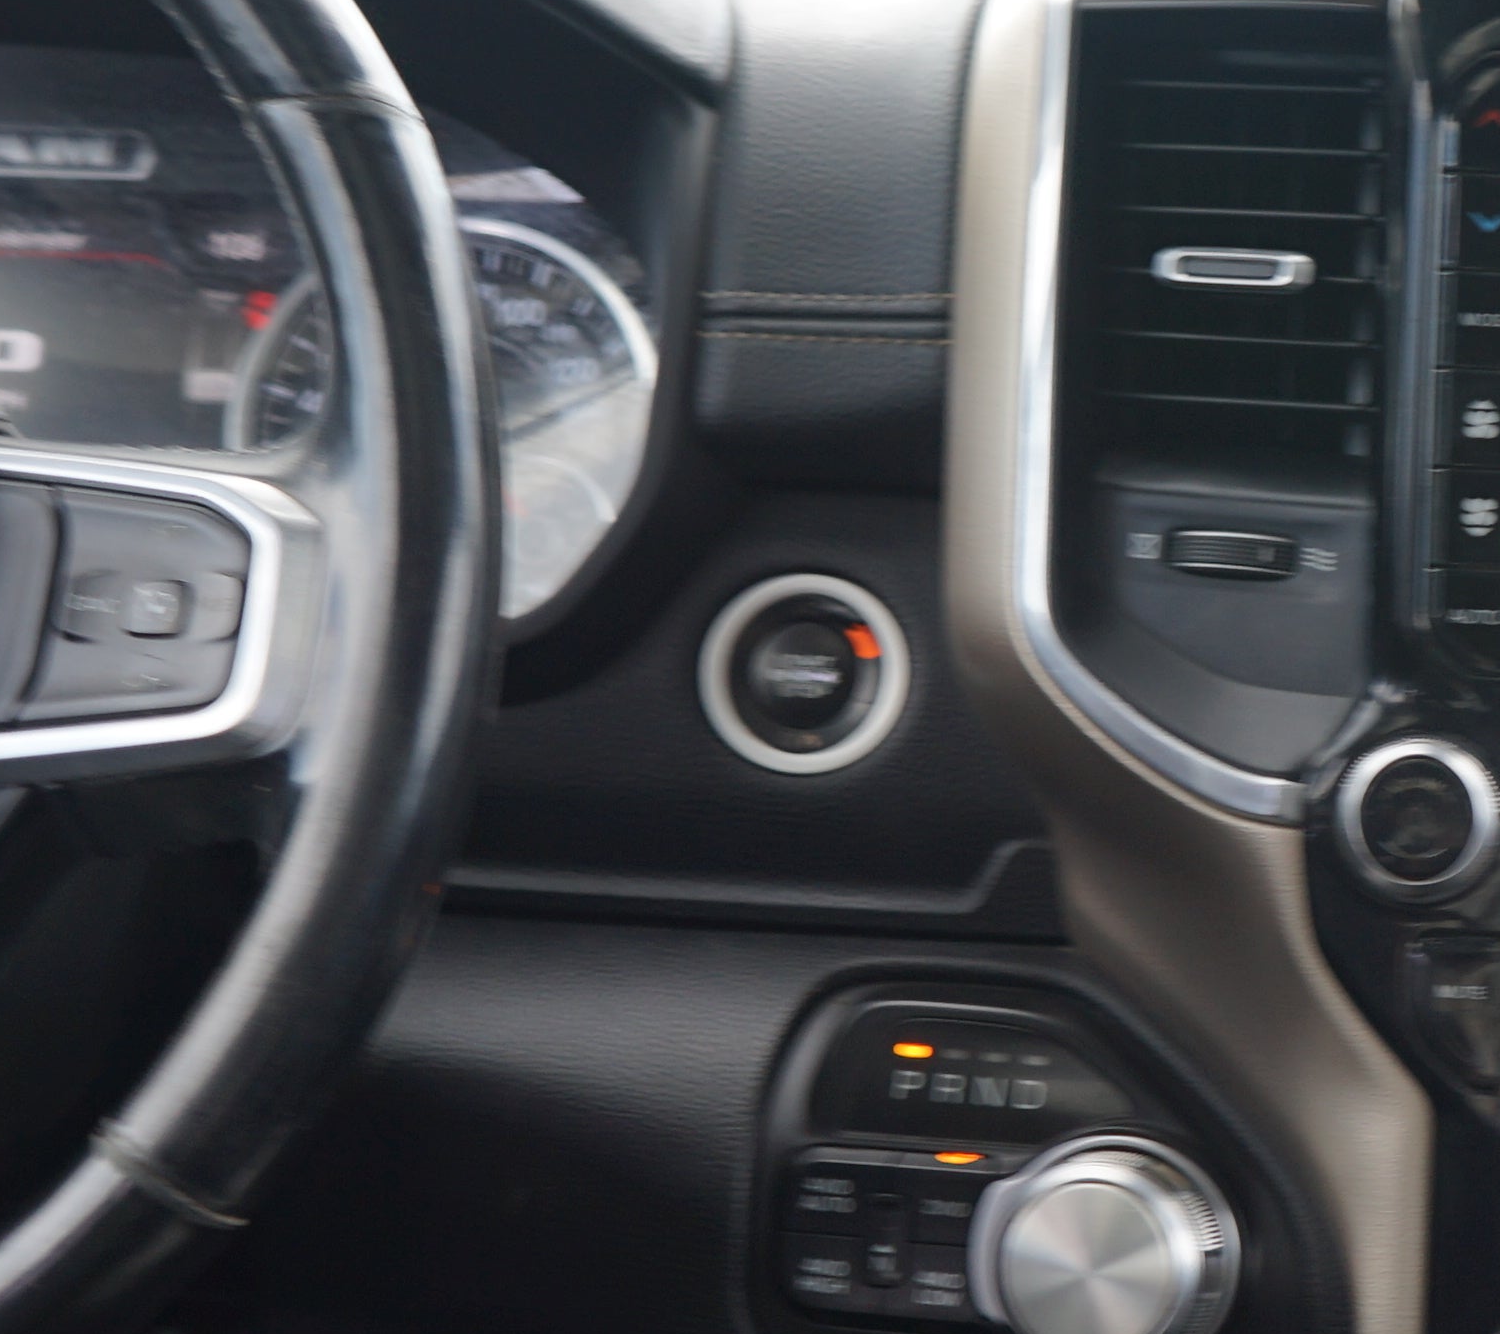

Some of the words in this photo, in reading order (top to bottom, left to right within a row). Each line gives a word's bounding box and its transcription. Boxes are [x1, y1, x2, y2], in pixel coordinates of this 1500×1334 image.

[890, 1070, 927, 1099] P
[929, 1074, 967, 1104] R
[968, 1076, 1008, 1107] N
[1008, 1079, 1048, 1110] D
